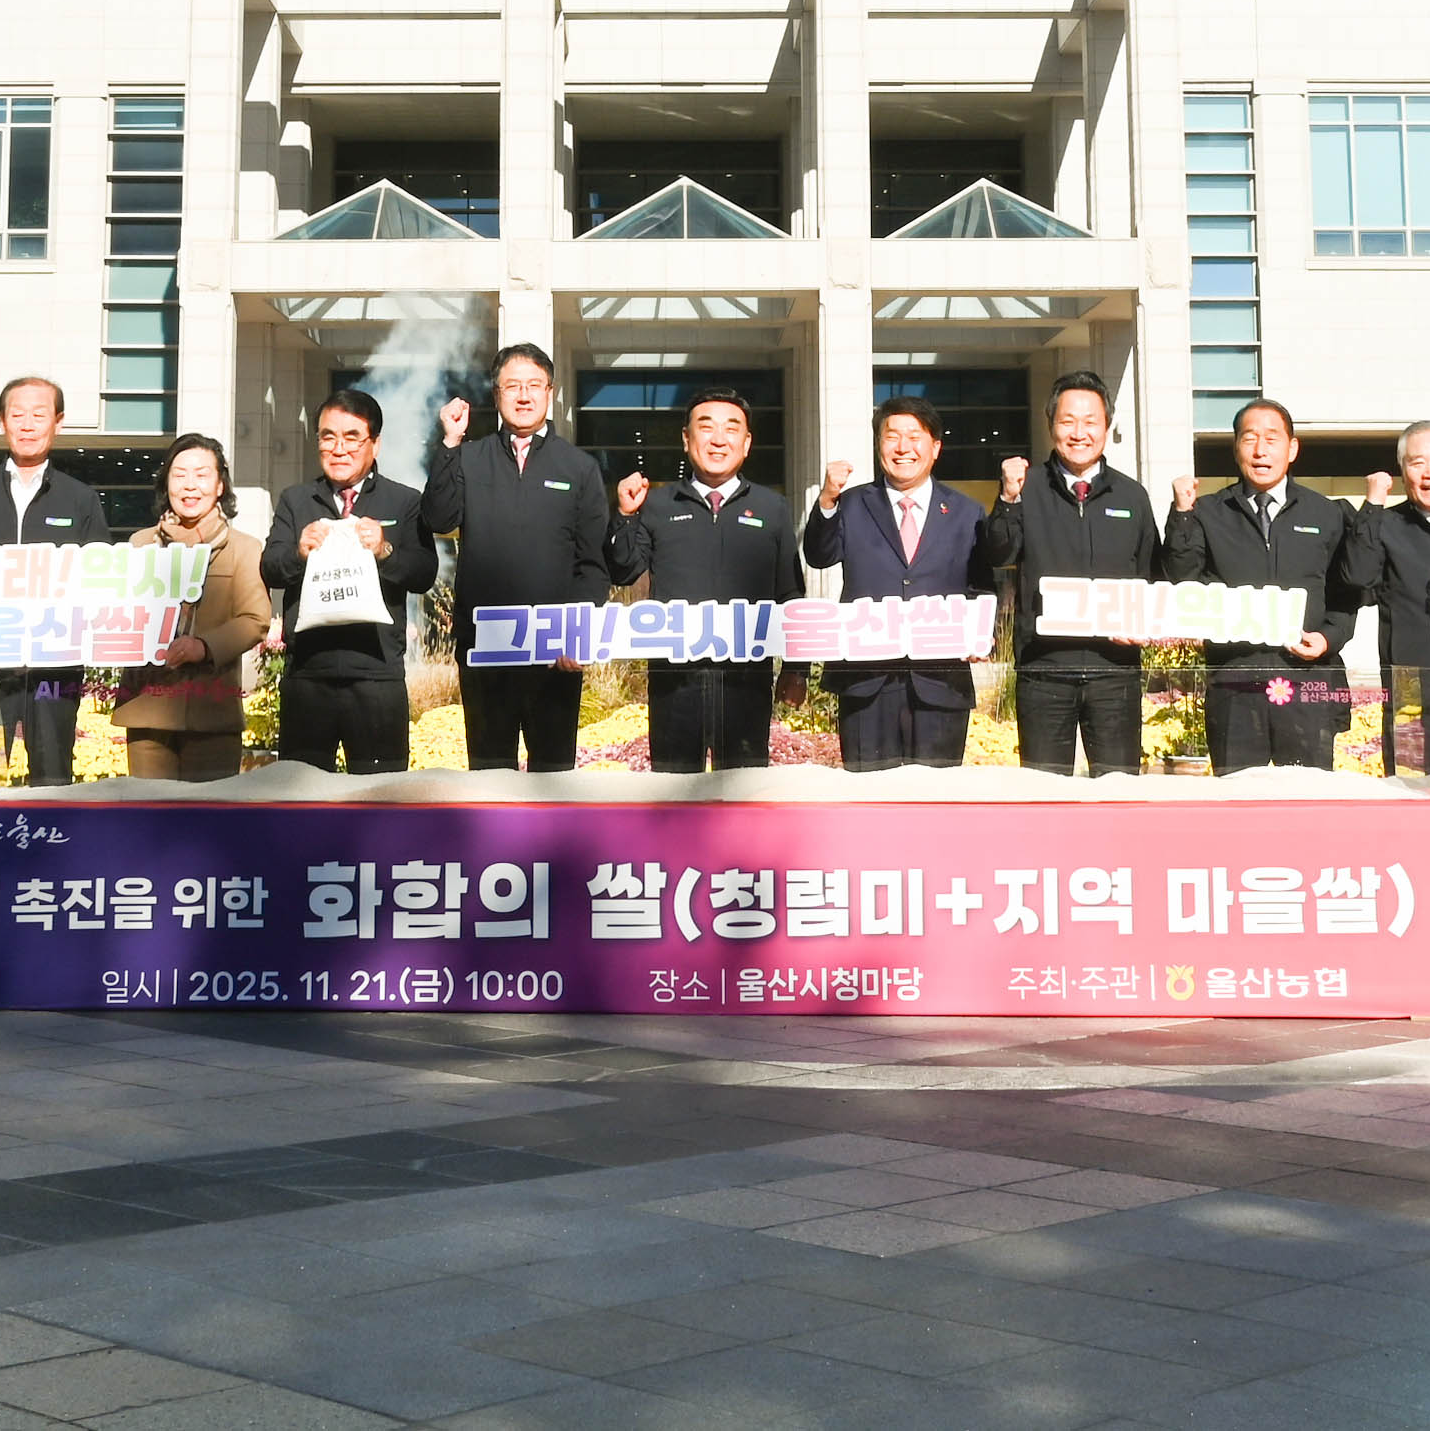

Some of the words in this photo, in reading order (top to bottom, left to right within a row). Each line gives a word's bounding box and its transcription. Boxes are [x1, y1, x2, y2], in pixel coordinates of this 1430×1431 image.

[82, 546, 210, 601] 역시!
[311, 566, 364, 583] 울산광역시
[319, 585, 359, 603] 청렴미
[1042, 580, 1167, 638] 그래!
[1175, 582, 1304, 644] 역시!
[472, 605, 618, 664] 그래!
[630, 601, 772, 661] 역시!
[783, 597, 995, 659] 울산쌀!
[1300, 681, 1329, 691] 2028
[10, 875, 158, 931] 촉진을
[172, 875, 268, 928] 위한
[303, 860, 552, 941] 화합의
[587, 861, 1134, 941] 쌀(청렴미+지역
[1167, 860, 1417, 939] 마을쌀)
[102, 969, 160, 1004] 일시
[189, 971, 288, 1003] 2025.
[299, 971, 338, 1002] 11.
[350, 964, 455, 1005] 21.(금)
[465, 970, 564, 1003] 10:00
[649, 969, 711, 1004] 장소
[738, 967, 924, 1004] 울산시청마당
[1007, 966, 1141, 1002] 주최·주관
[1206, 966, 1349, 1000] 울산농협
